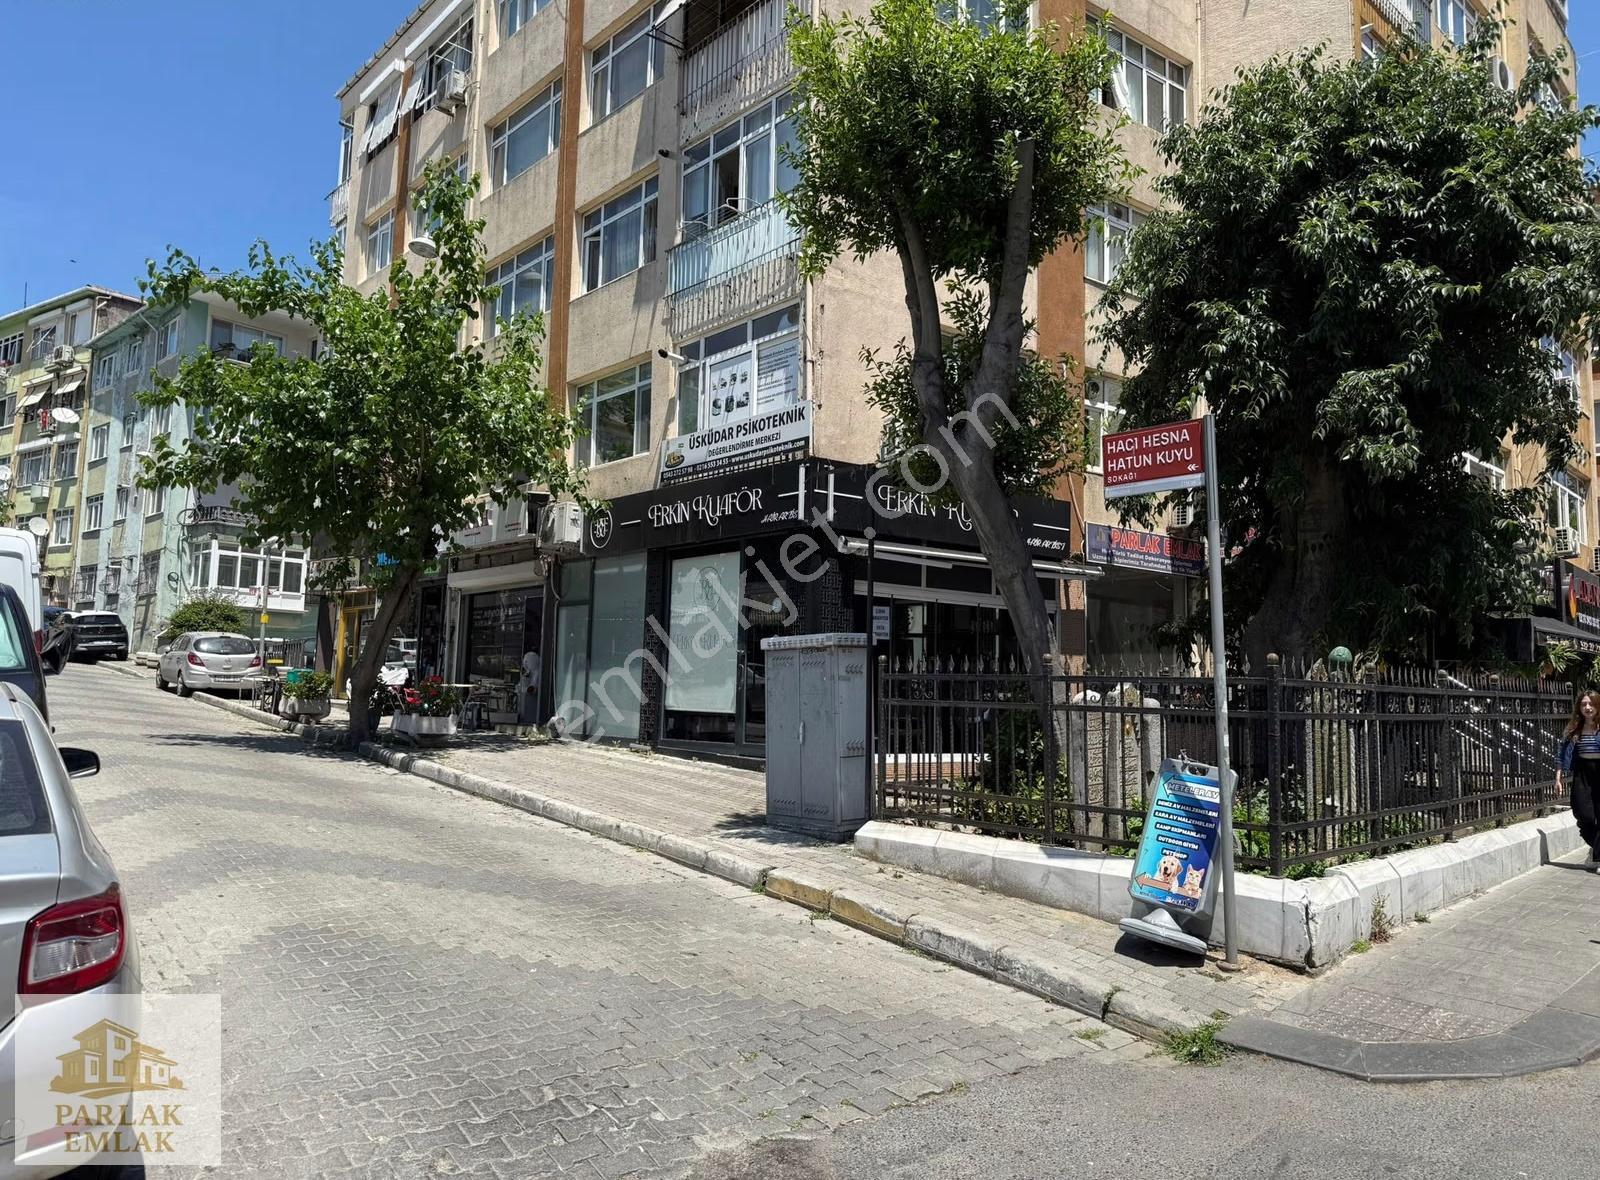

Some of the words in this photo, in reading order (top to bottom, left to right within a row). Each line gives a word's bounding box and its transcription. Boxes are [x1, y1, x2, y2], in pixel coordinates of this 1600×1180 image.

[688, 426, 734, 450] ÜSKÜDAR
[735, 405, 806, 437] PSİKOTEKNİK
[1142, 428, 1190, 449] HESNA
[708, 438, 754, 458] DEĞERLENDİRME
[755, 431, 781, 446] MERKEZİ
[722, 457, 729, 466] 55
[1107, 454, 1152, 472] HATUN
[1156, 446, 1193, 465] KUYU
[1107, 472, 1137, 484] SOKAĞI
[648, 500, 690, 528] ERKİN
[692, 486, 763, 527] KUAFÖR
[1110, 527, 1161, 555] PARLAK
[1163, 538, 1202, 562] EMLAK
